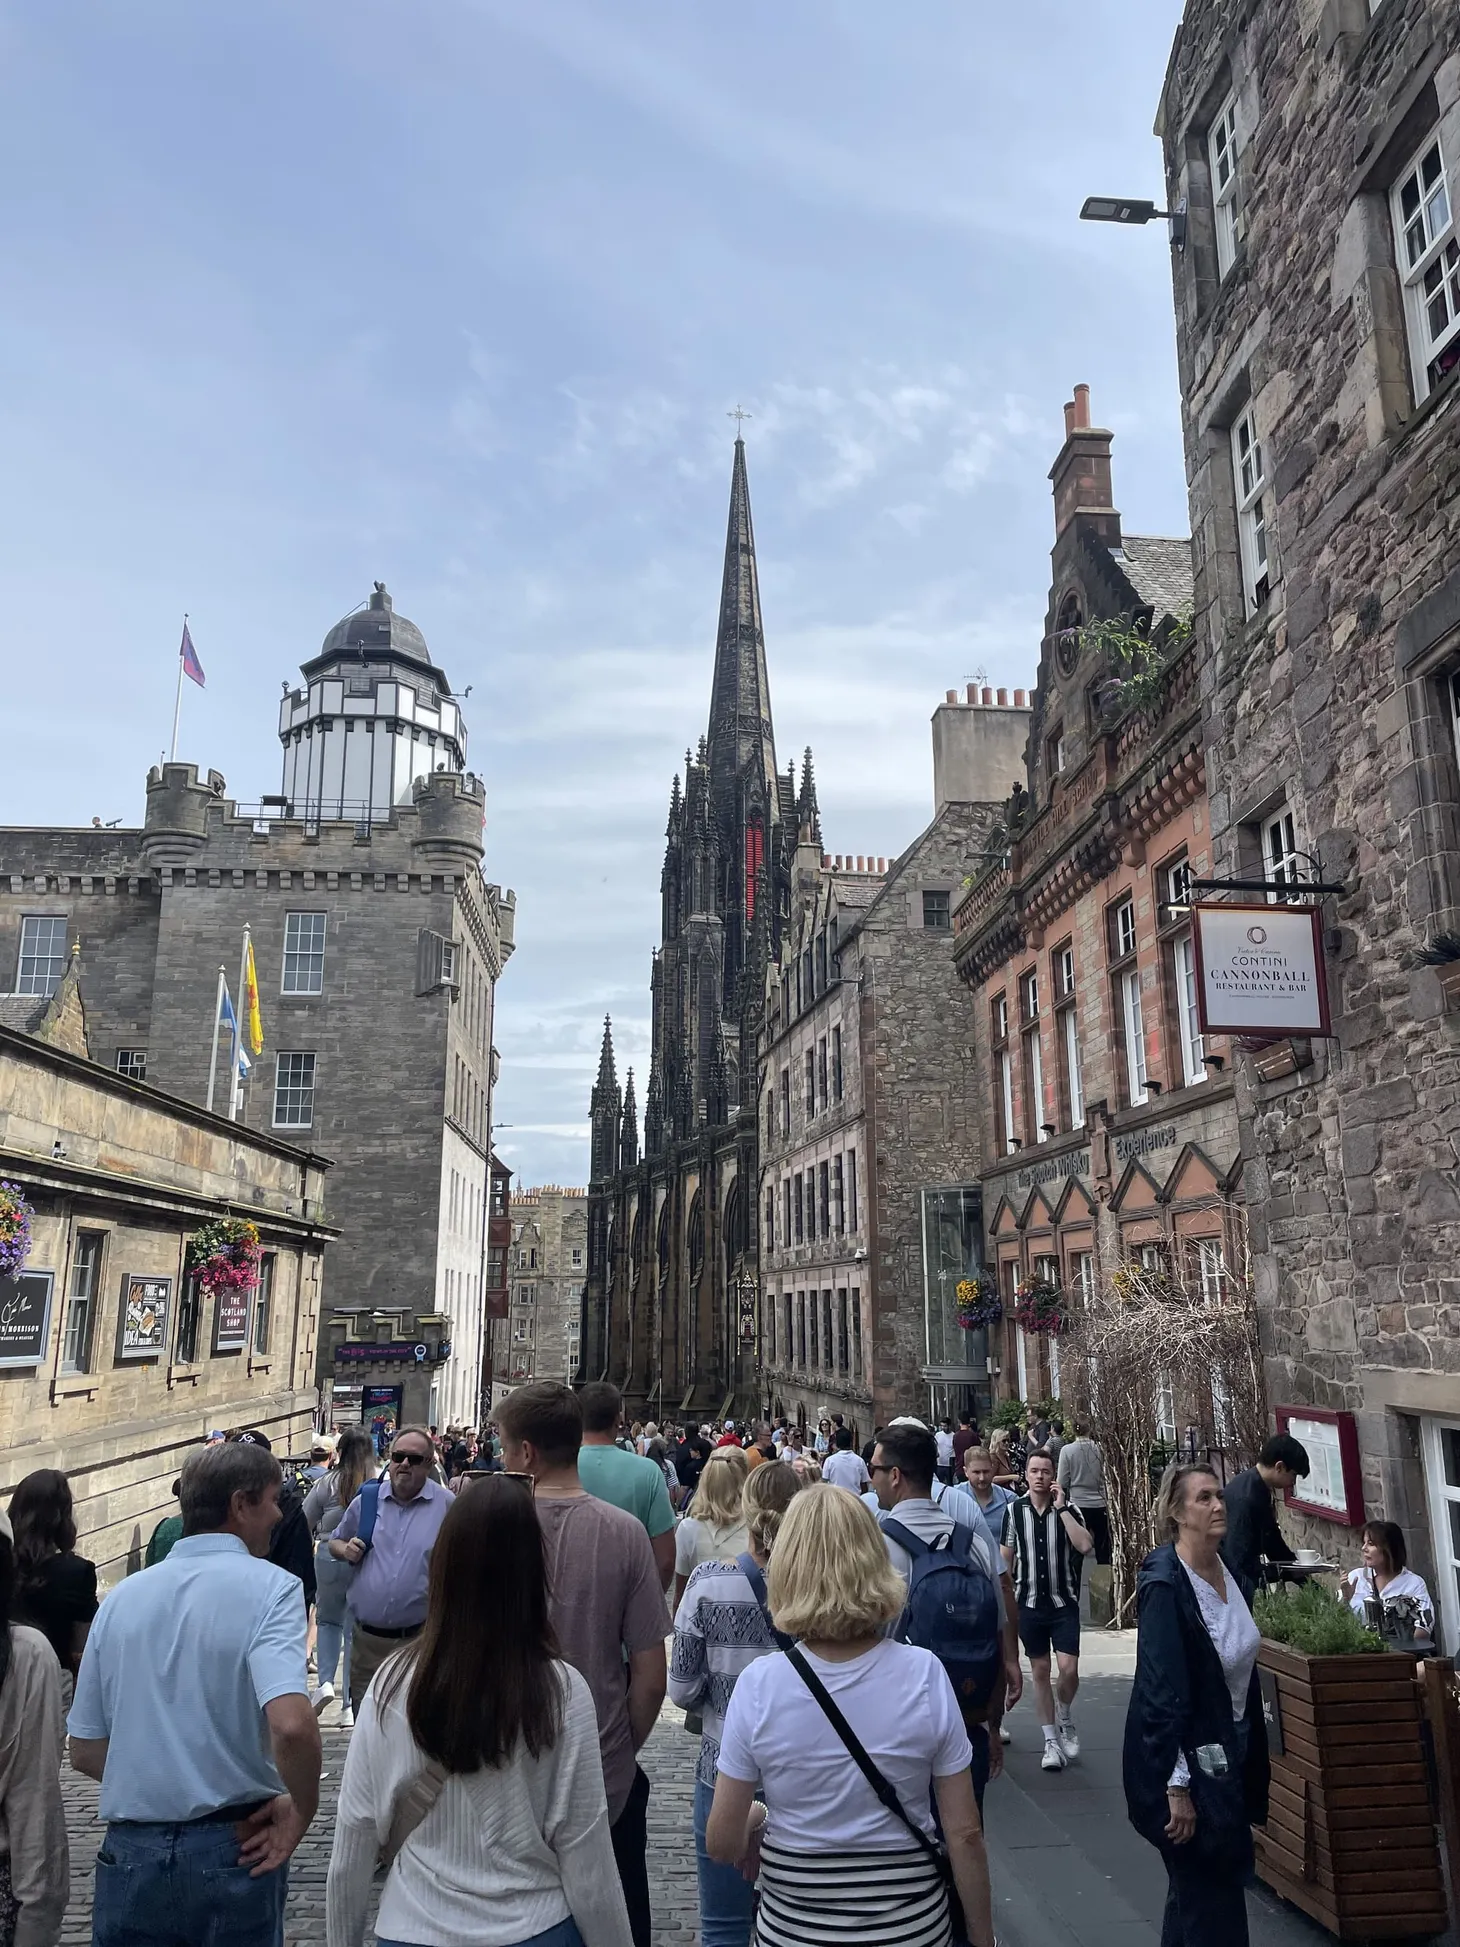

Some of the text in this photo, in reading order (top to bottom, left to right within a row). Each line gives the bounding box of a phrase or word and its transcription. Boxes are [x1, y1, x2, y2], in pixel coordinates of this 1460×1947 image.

[1231, 956, 1287, 967] CONTINI
[1210, 969, 1310, 982] CANNONBALL
[1216, 982, 1307, 992] RESTAURANT & BAR
[1058, 1151, 1089, 1176] Whisky
[1115, 1125, 1176, 1161] Experience
[230, 1296, 241, 1305] THE
[221, 1307, 247, 1317] SCOTLAND
[226, 1318, 240, 1327] SHOP
[8, 1325, 40, 1333] MORRISON
